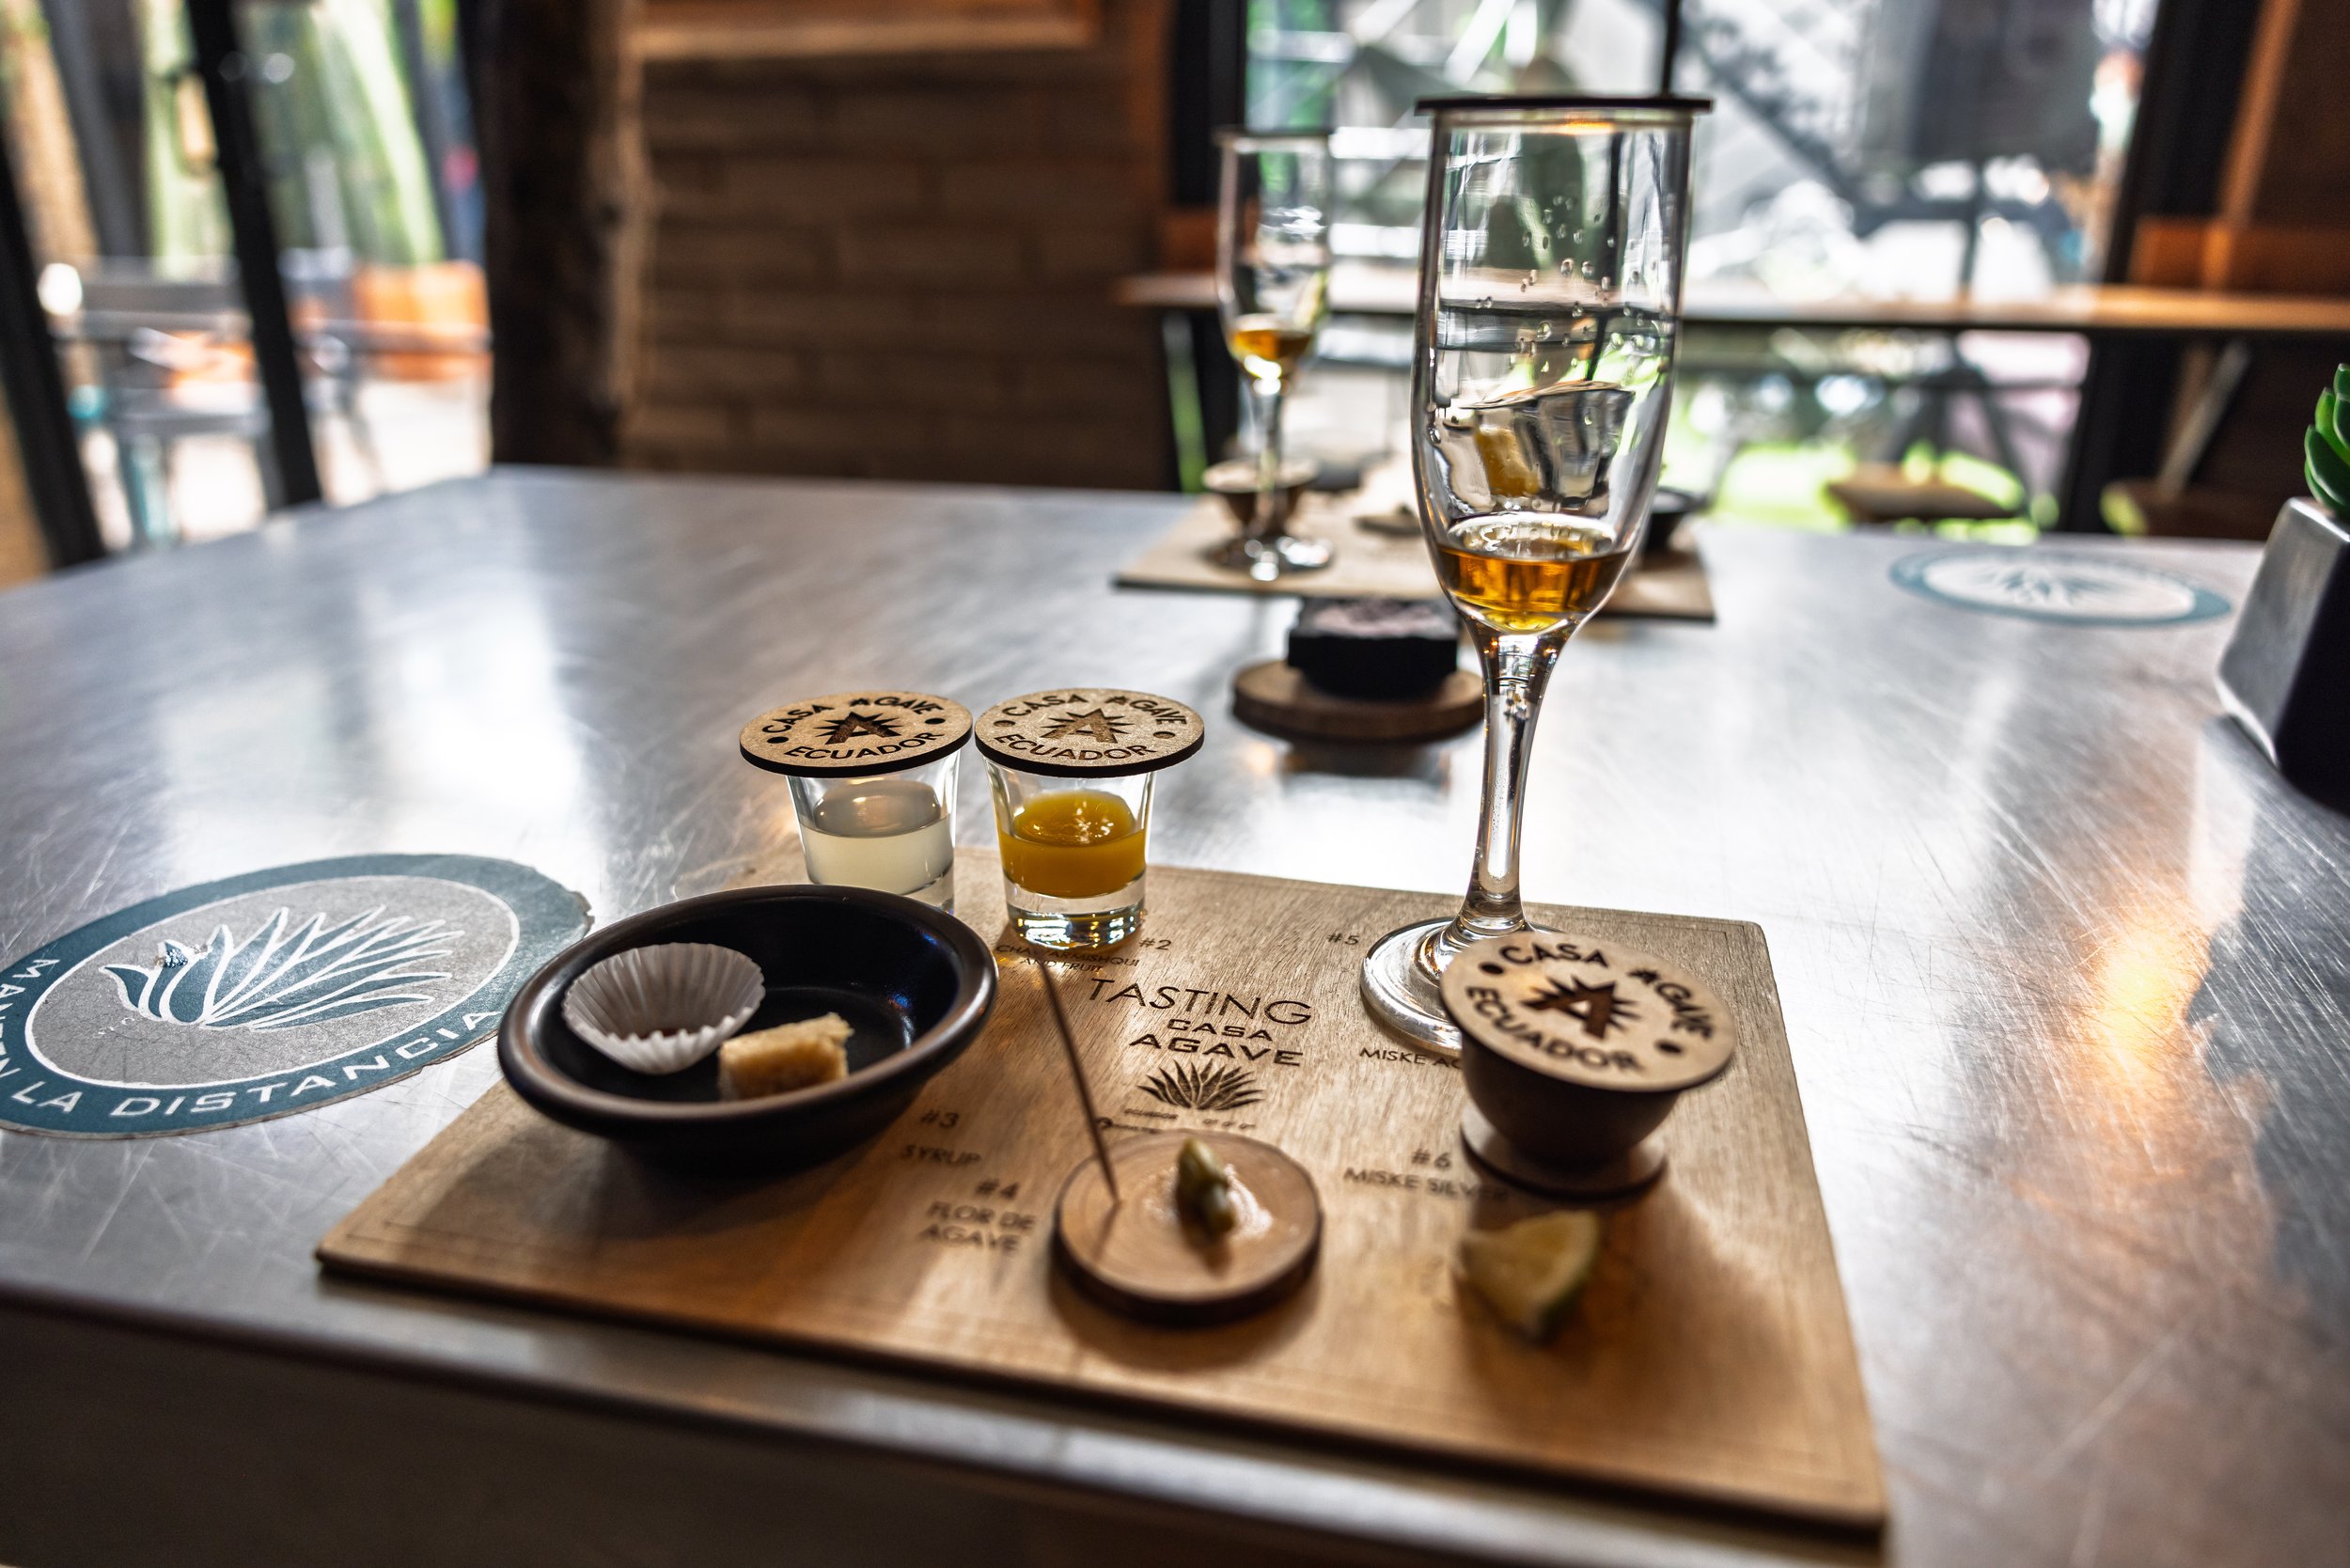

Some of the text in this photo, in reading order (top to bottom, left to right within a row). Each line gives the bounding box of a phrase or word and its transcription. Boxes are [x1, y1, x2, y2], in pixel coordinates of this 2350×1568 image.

[762, 704, 835, 734] CASA
[1001, 694, 1187, 726] CASA AGAVE
[784, 731, 945, 760] ECUADOR
[994, 733, 1156, 761] ECUADOR
[1138, 937, 1172, 951] #2
[1327, 933, 1360, 946] #5
[995, 943, 1141, 968] CHAARMISHQUI
[1061, 961, 1104, 974] FRUIT
[1498, 942, 1609, 968] CASA
[1089, 978, 1312, 1025] TASTING
[1167, 1018, 1274, 1042] CASA
[1465, 985, 1644, 1072] ECUADOR
[1129, 1033, 1304, 1067] AGAVE
[1359, 1047, 1428, 1066] MISKE
[11, 1080, 83, 1114] LA
[110, 1010, 503, 1117] DISTANCIA
[919, 1108, 960, 1128] #3
[902, 1143, 981, 1167] SYRUP
[1410, 1147, 1451, 1170] #6
[975, 1178, 1020, 1200] #4
[1343, 1166, 1419, 1189] MISKE
[926, 1200, 995, 1225] FLOR
